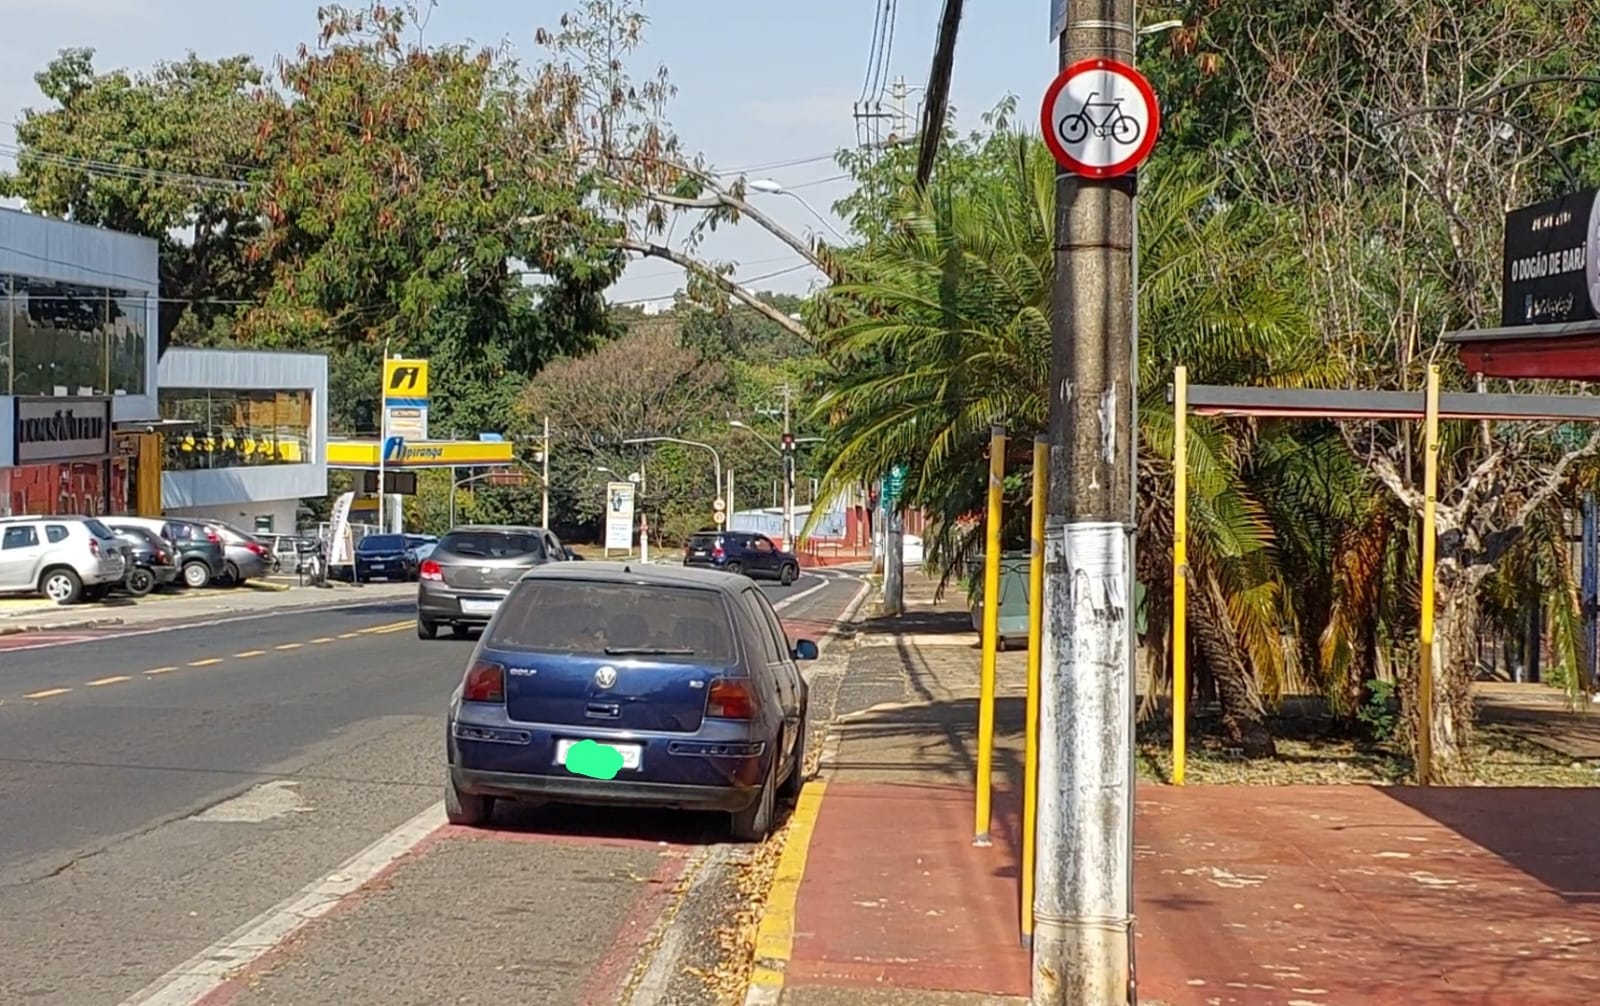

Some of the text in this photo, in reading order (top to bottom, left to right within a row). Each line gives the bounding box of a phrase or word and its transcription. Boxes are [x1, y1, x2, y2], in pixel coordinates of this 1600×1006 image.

[1512, 260, 1518, 282] O
[1519, 250, 1547, 280] DOGÃO
[1548, 253, 1560, 277] DE
